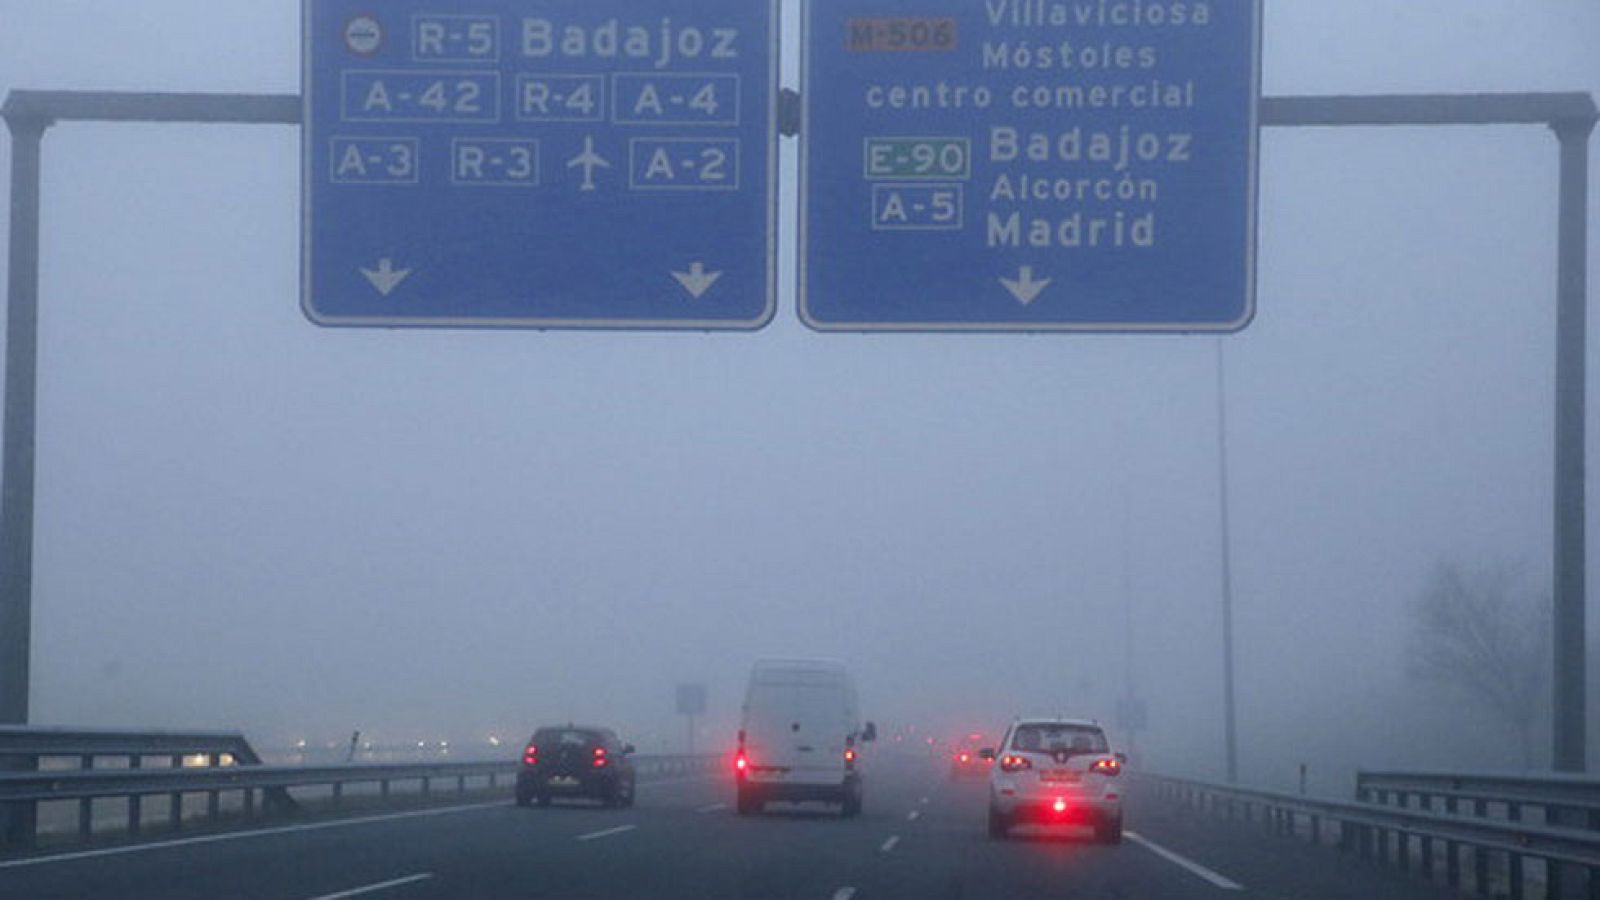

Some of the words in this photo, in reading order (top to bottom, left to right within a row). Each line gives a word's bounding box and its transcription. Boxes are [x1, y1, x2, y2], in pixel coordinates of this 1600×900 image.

[985, 0, 1210, 26] Villaviciosa
[419, 21, 493, 54] R-5
[523, 18, 737, 67] Badajoz
[851, 22, 953, 48] M-506
[983, 41, 1156, 69] Móstoles
[364, 81, 480, 112] A-42
[523, 84, 594, 113] R-4
[634, 85, 719, 114] A-4
[866, 82, 991, 108] centro
[1013, 80, 1194, 108] comercial
[337, 145, 411, 175] A-3
[458, 147, 532, 177] R-3
[645, 148, 726, 179] A-2
[870, 145, 963, 173] E-90
[990, 127, 1192, 170] Badajoz
[991, 174, 1157, 200] Alcorcón
[881, 193, 955, 221] A-5
[987, 212, 1154, 247] Madrid
